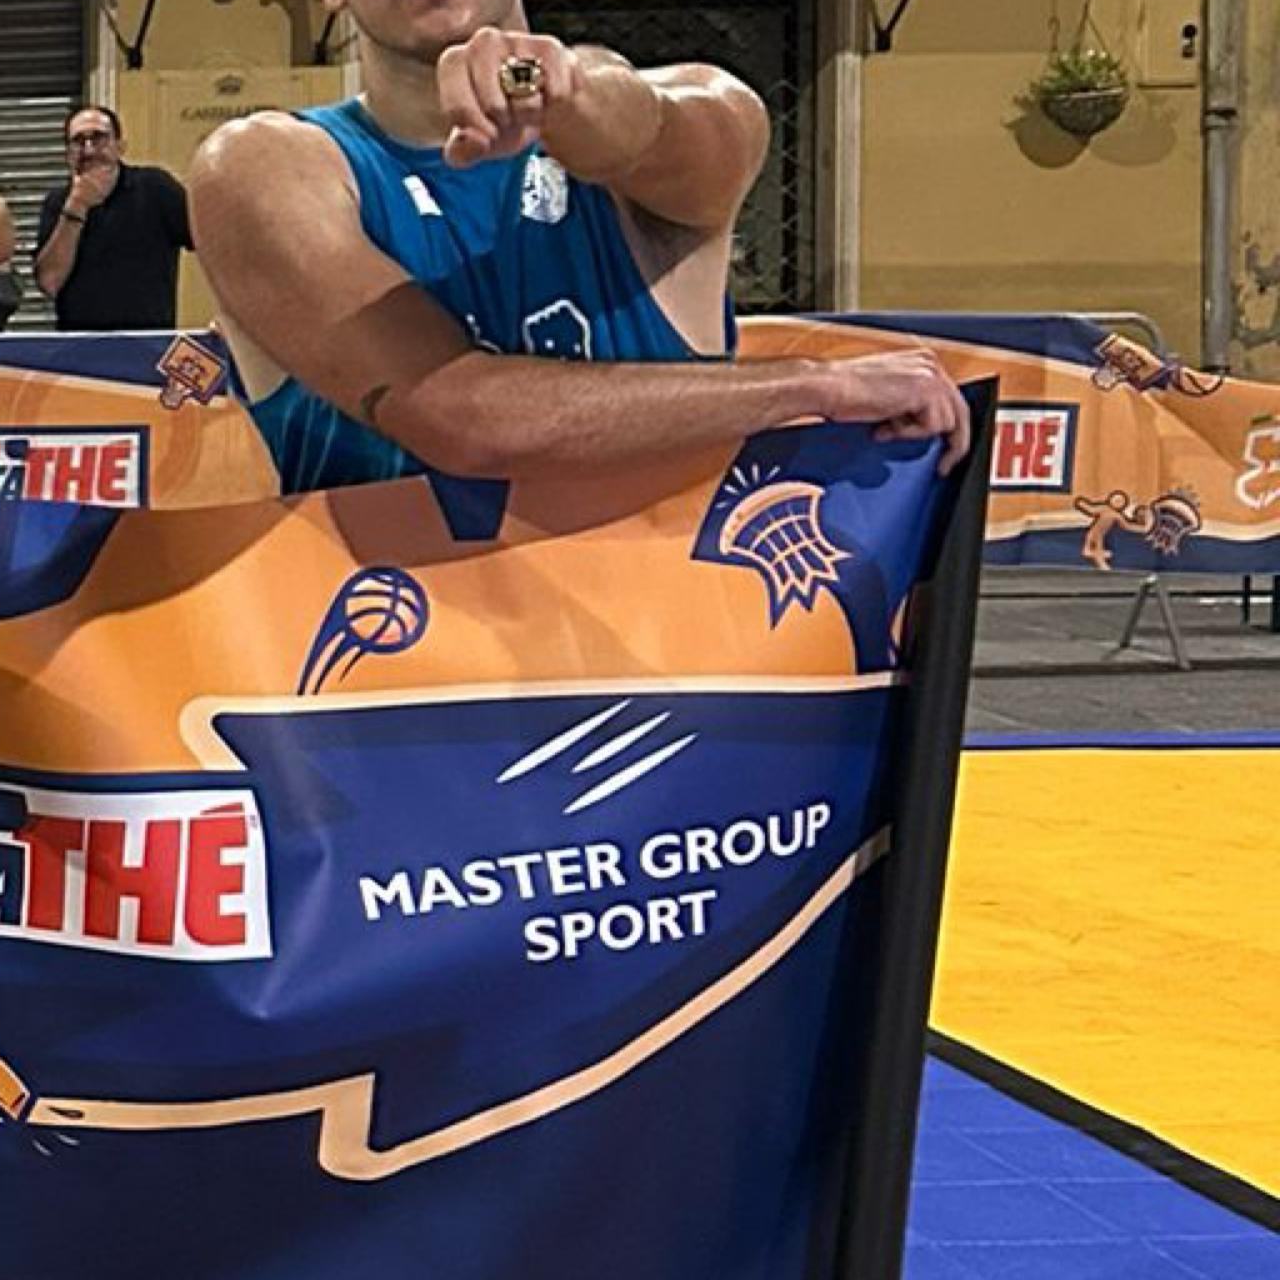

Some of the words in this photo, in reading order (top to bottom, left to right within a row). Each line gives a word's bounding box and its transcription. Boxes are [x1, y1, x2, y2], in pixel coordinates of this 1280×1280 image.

[359, 843, 626, 921] MASTER
[640, 802, 831, 880] GROUP
[524, 889, 717, 962] SPORT
